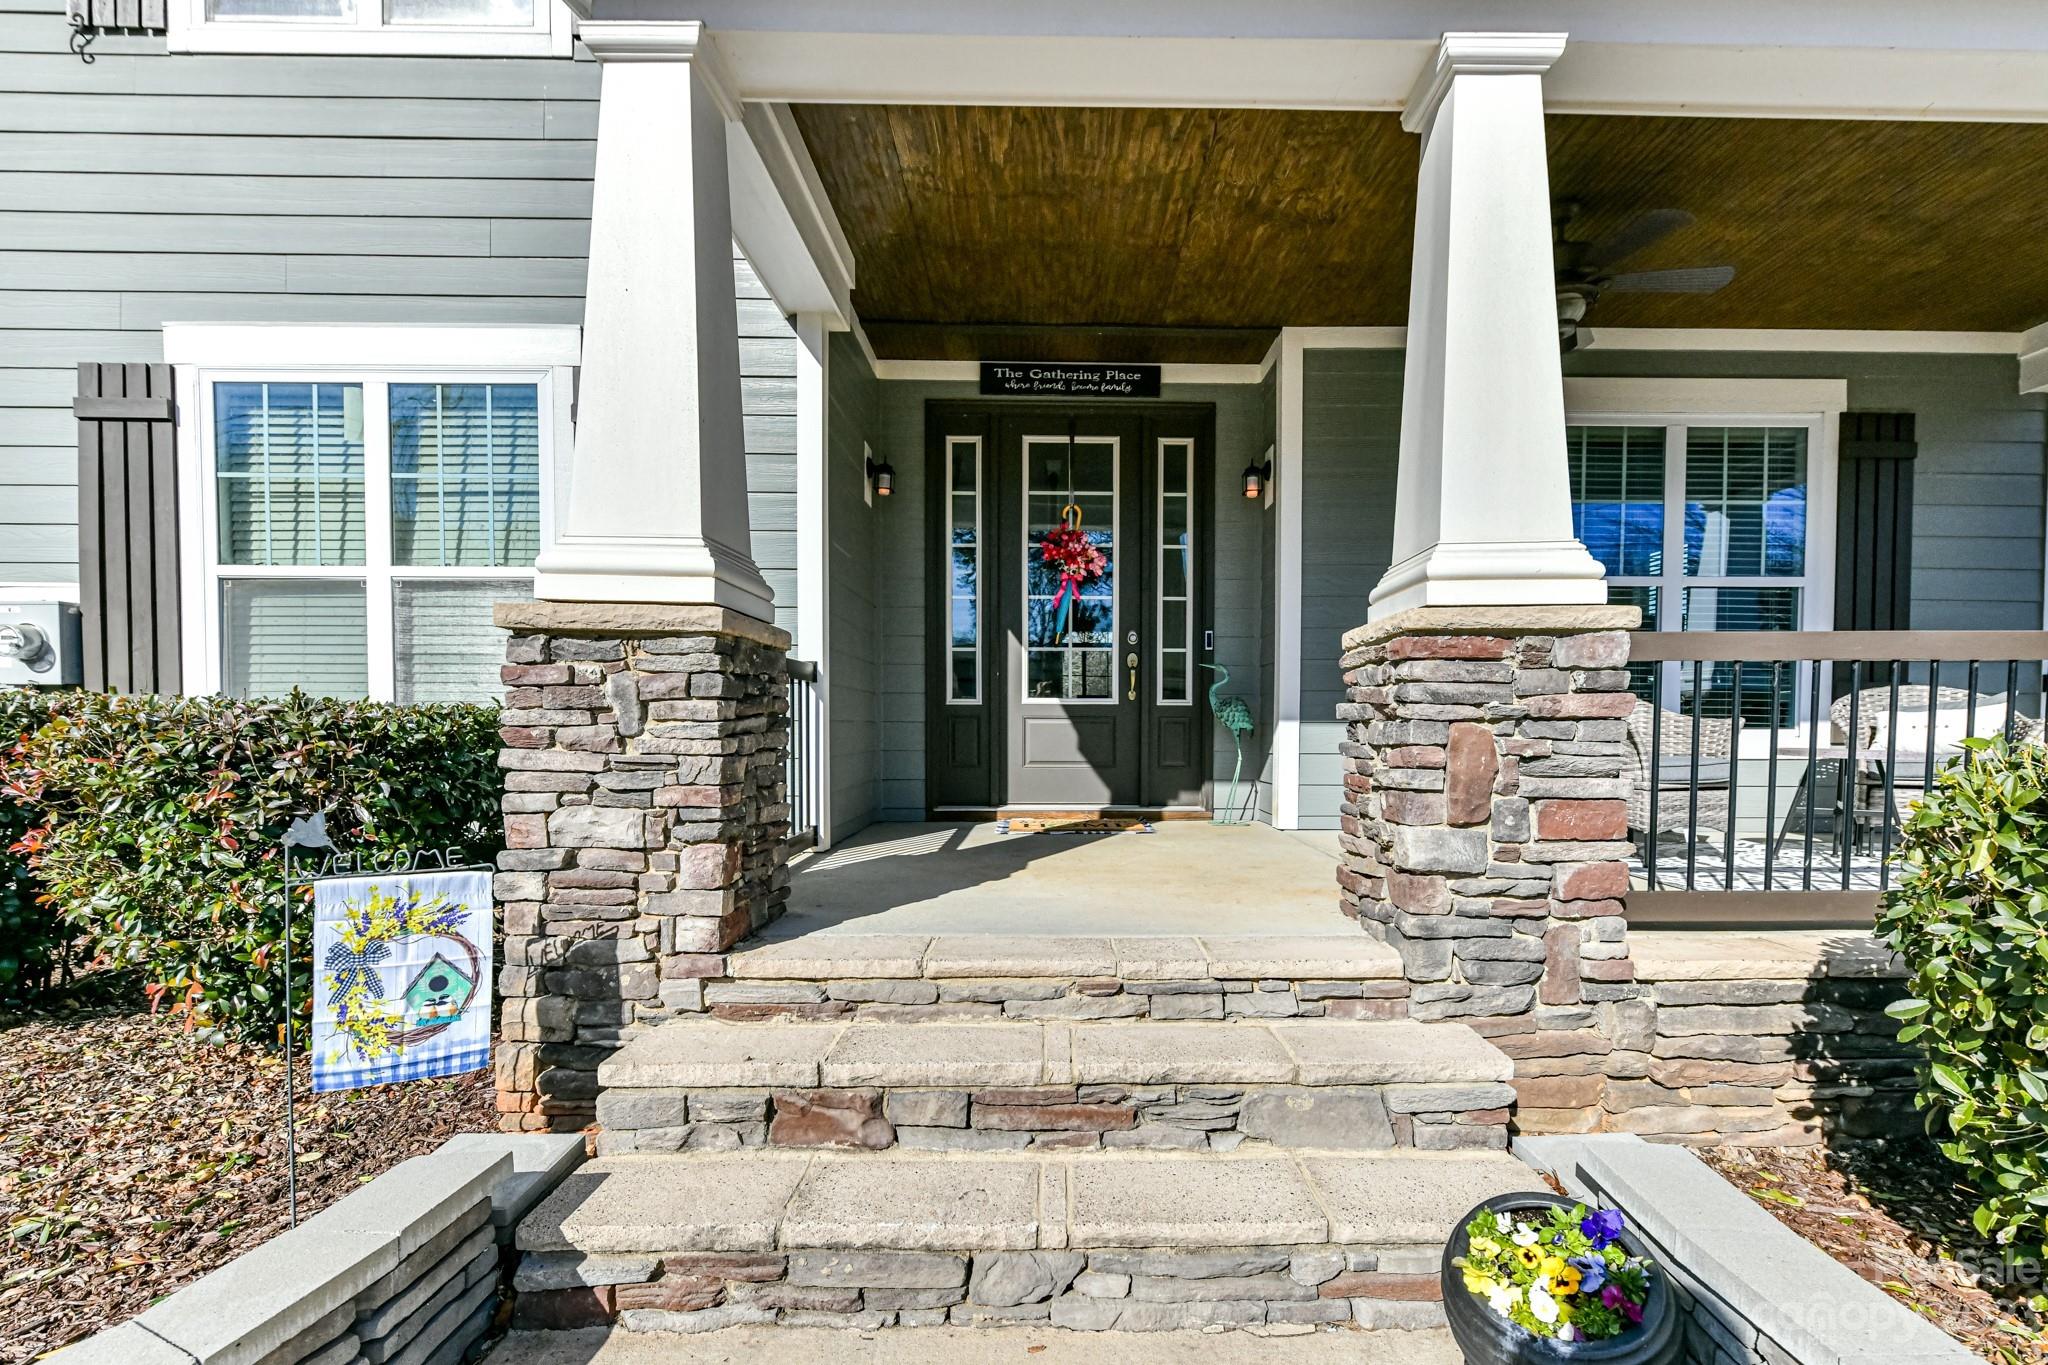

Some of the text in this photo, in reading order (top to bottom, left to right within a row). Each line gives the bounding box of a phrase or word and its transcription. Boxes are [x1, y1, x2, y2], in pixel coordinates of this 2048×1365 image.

[993, 367, 1142, 382] The Gathering Place
[1004, 378, 1031, 390] where
[1033, 380, 1066, 391] friends
[1100, 381, 1133, 394] family
[293, 846, 465, 879] WELCOME
